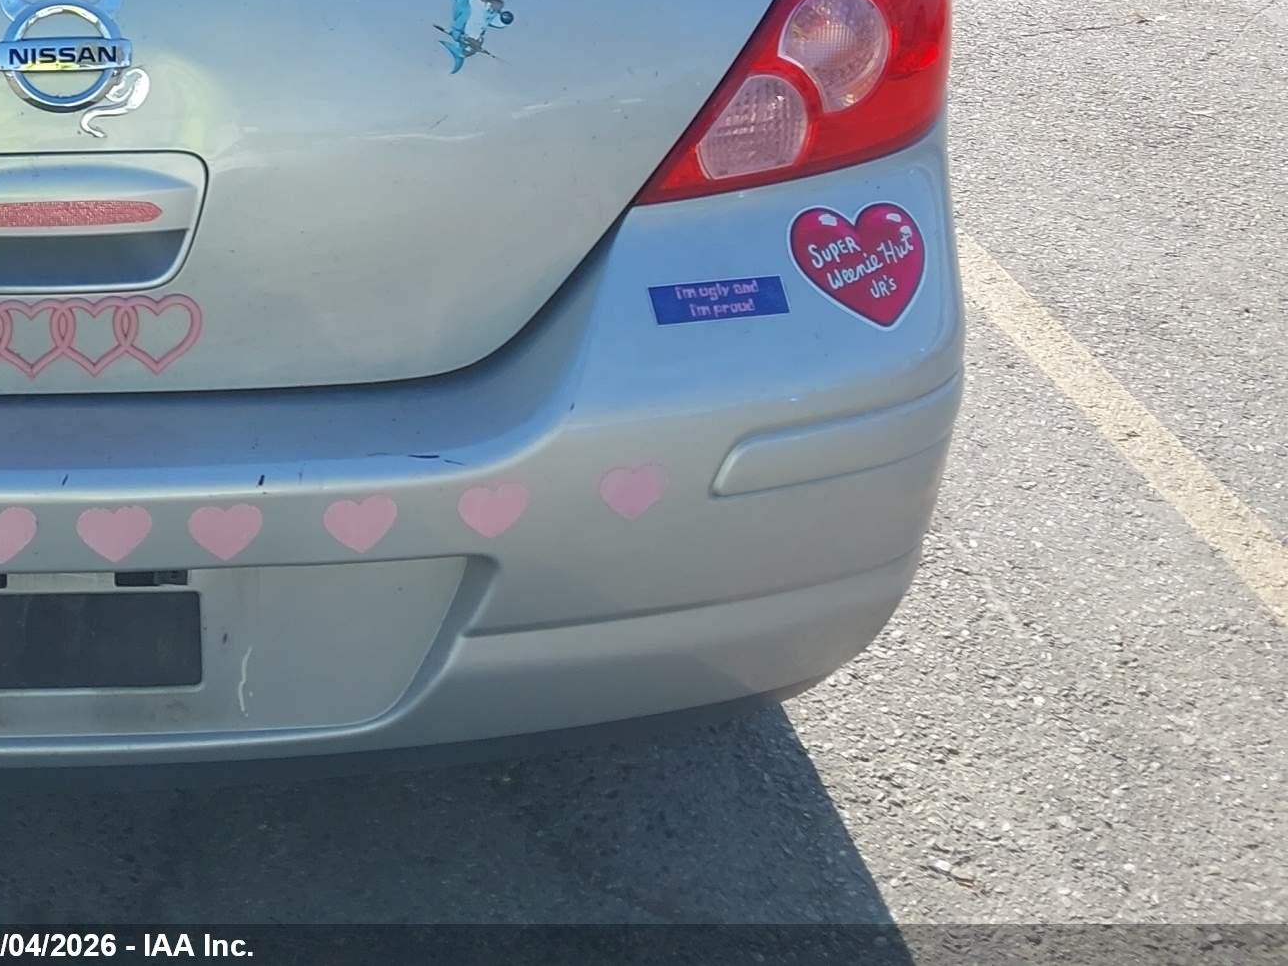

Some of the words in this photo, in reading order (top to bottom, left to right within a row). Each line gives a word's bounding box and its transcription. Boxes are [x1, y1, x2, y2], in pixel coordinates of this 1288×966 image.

[9, 45, 116, 64] NISSAN
[826, 253, 884, 289] Weenie
[877, 233, 914, 264] Hut
[698, 283, 730, 302] ugly
[732, 280, 759, 294] and
[712, 299, 755, 317] proud
